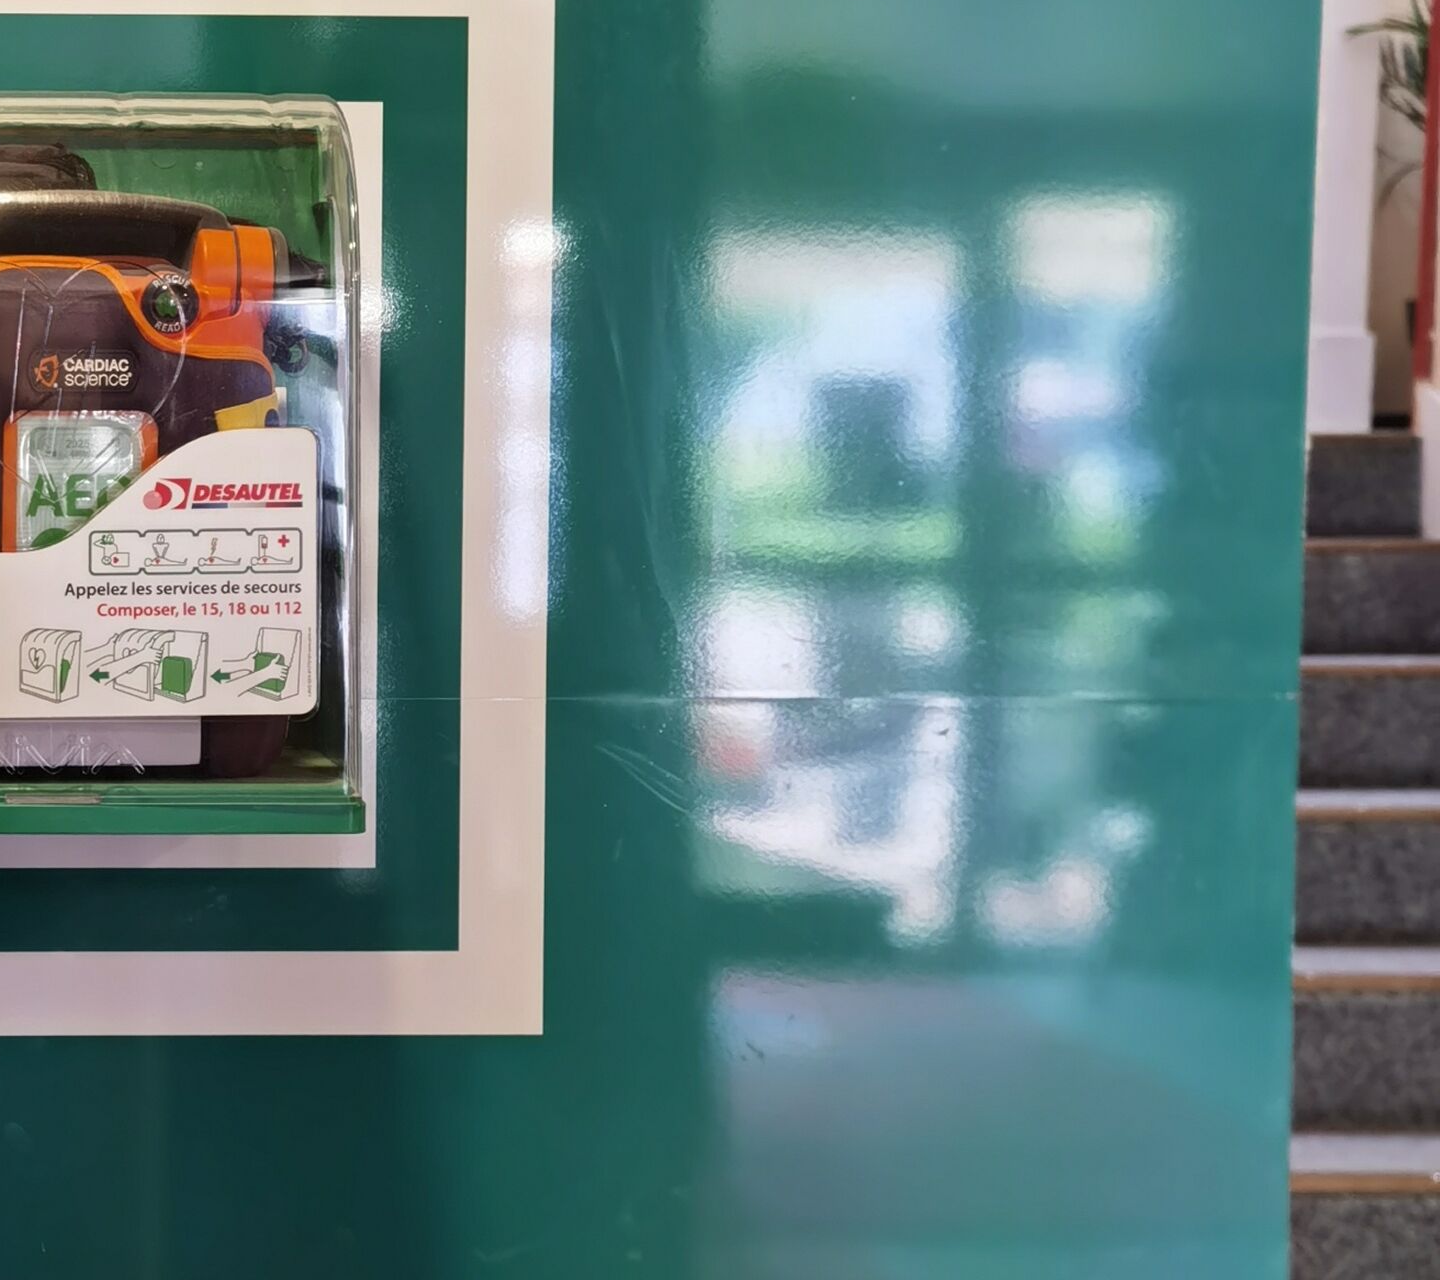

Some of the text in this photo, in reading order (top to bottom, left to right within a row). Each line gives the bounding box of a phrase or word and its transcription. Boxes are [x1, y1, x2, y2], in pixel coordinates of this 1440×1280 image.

[63, 358, 130, 372] CARDIAC
[193, 483, 303, 502] DESAUTEL
[64, 581, 302, 599] Appelez les services de secours
[97, 601, 302, 619] Composer, le 15, 18 ou 112
